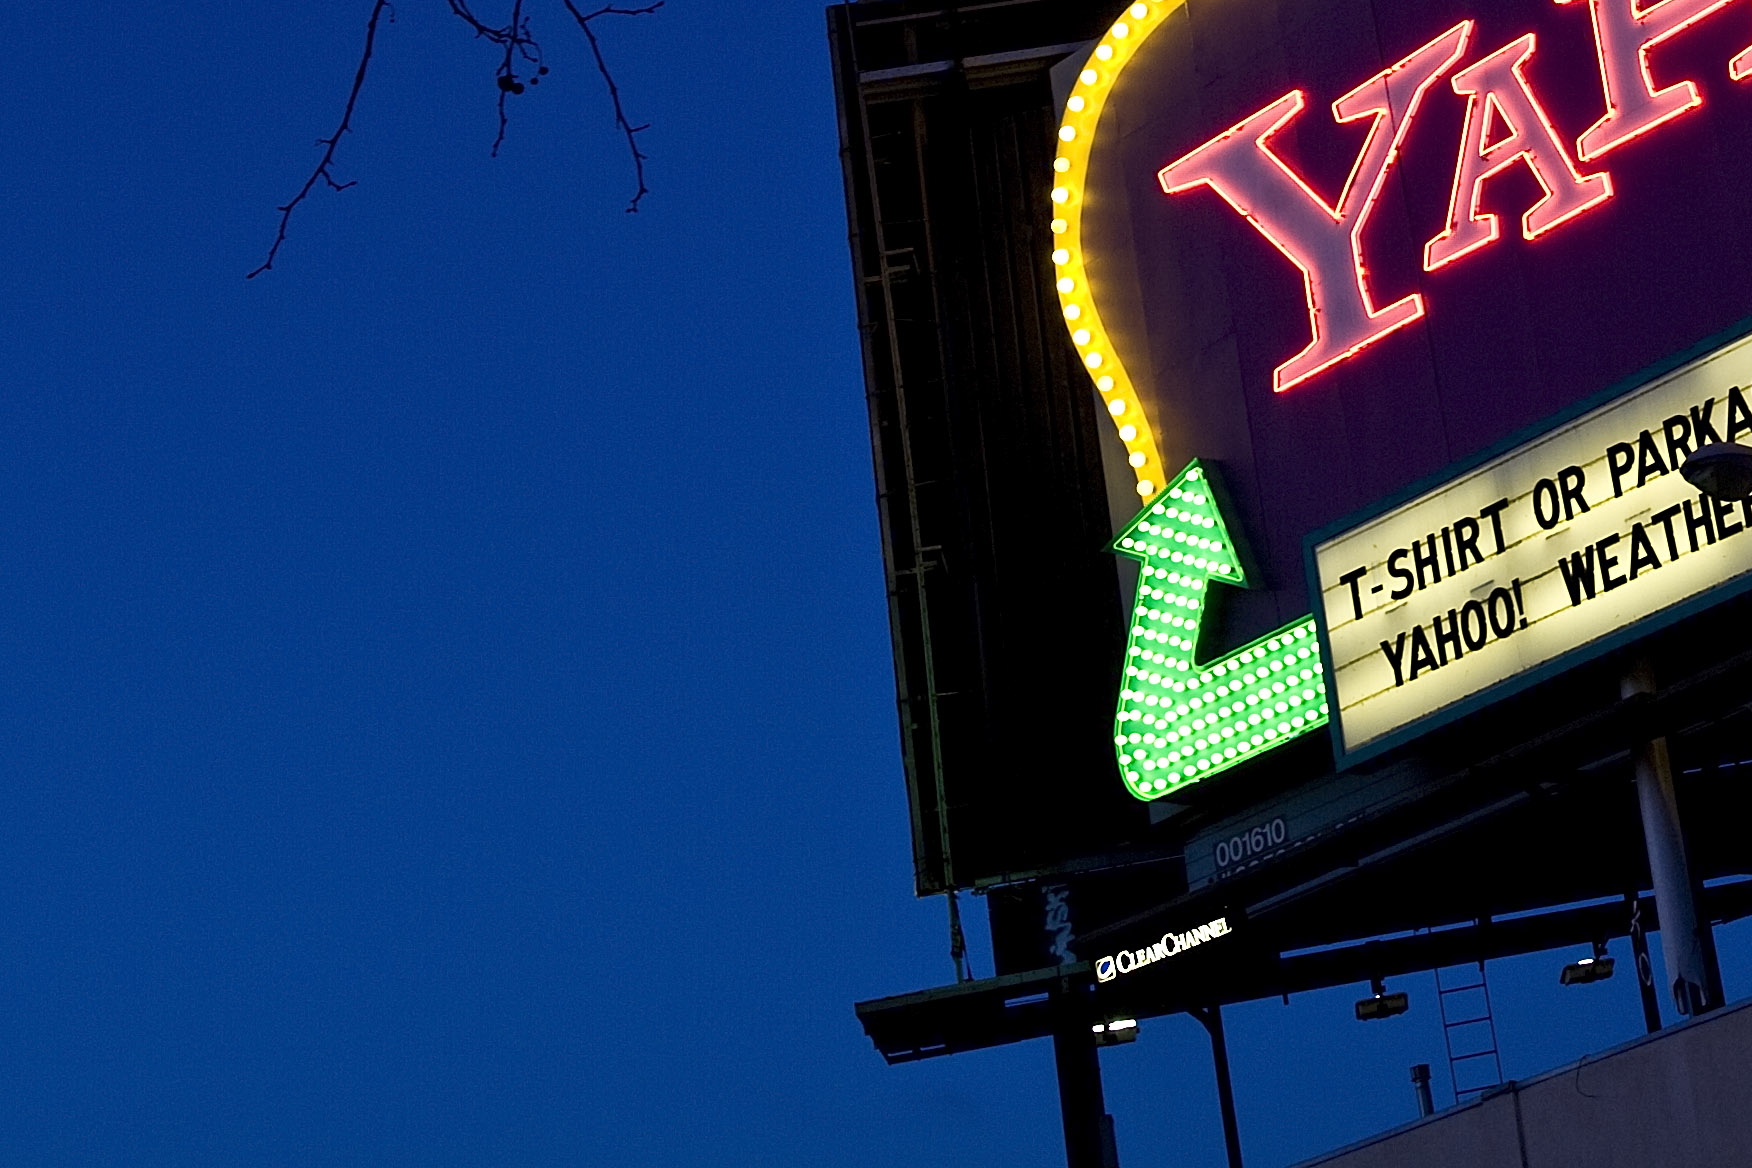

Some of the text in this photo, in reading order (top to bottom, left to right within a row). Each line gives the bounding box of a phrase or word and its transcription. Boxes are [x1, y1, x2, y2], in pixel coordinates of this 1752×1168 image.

[1340, 498, 1508, 620] T-SHIRT
[1532, 465, 1590, 531] OR
[1380, 578, 1527, 687] YAHOO!
[1216, 818, 1285, 868] 001610
